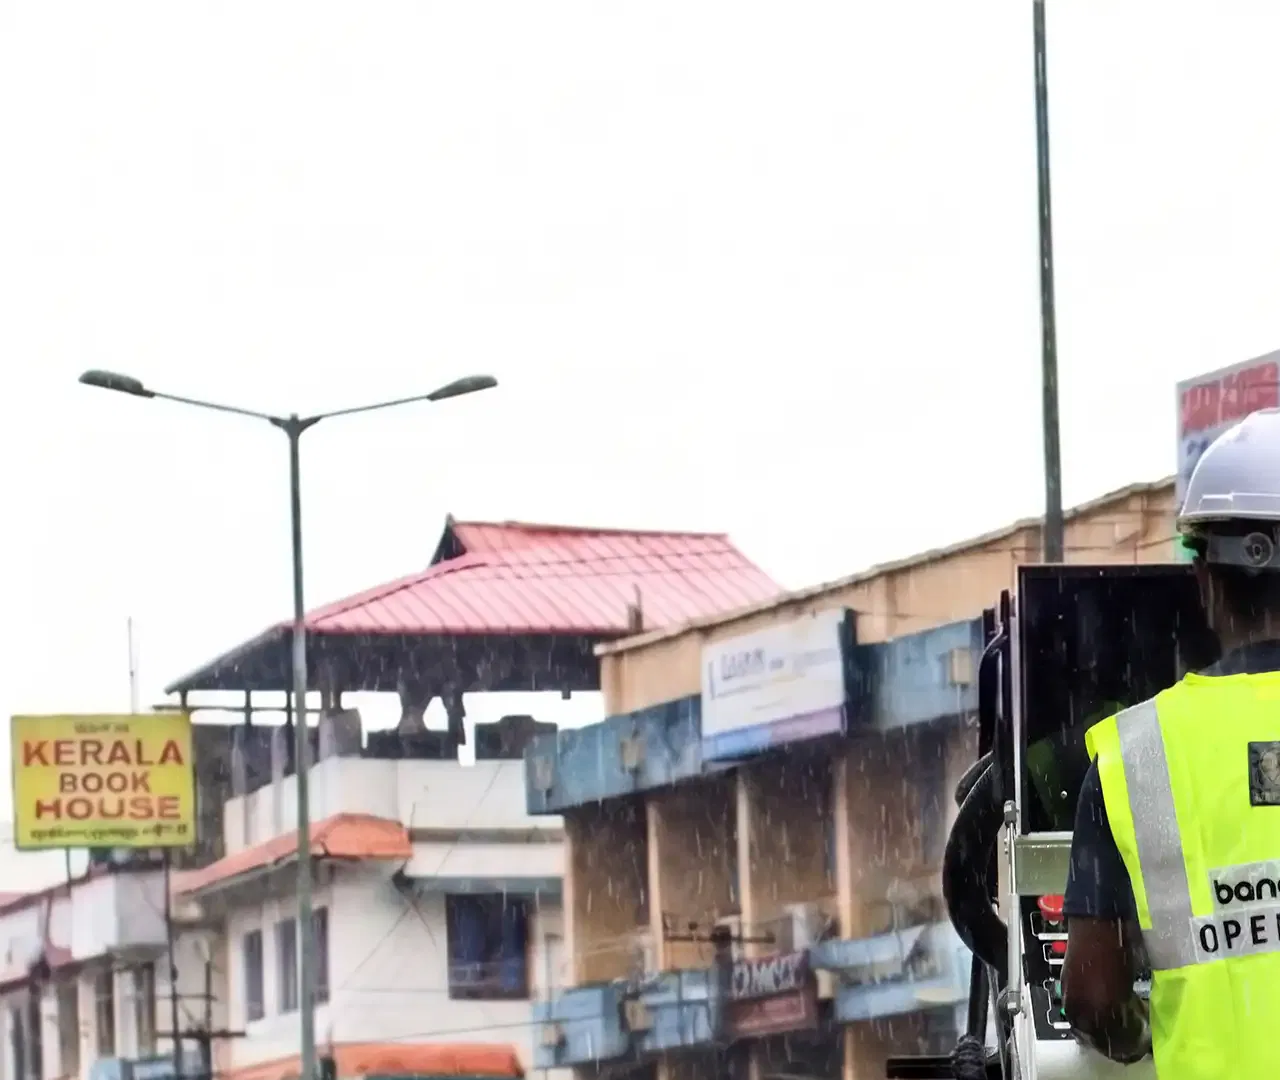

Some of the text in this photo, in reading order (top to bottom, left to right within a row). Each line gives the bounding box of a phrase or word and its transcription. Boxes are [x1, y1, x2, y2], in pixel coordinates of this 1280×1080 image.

[23, 739, 185, 768] KERALA
[59, 771, 152, 794] BOOK
[35, 796, 182, 821] HOUSE
